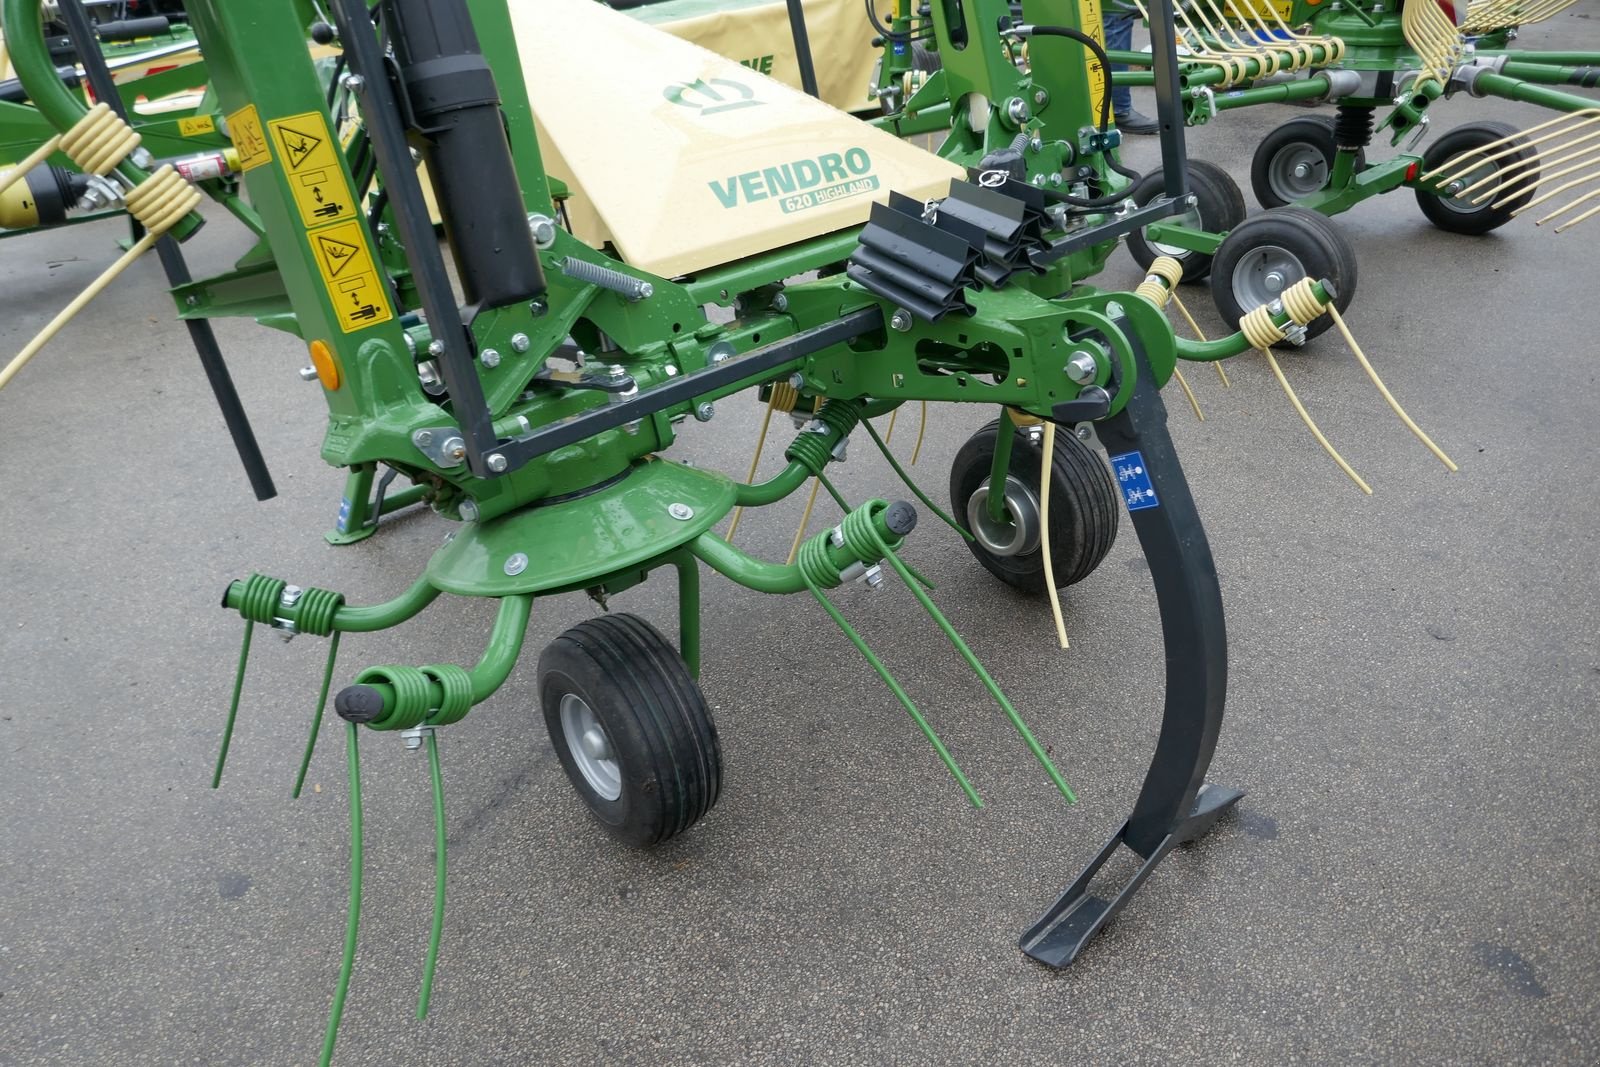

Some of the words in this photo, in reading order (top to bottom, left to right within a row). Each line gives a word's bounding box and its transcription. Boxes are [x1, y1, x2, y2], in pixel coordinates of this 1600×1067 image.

[707, 147, 872, 209] VENDRO
[786, 194, 812, 212] 620
[815, 179, 874, 203] HIGHLAND
